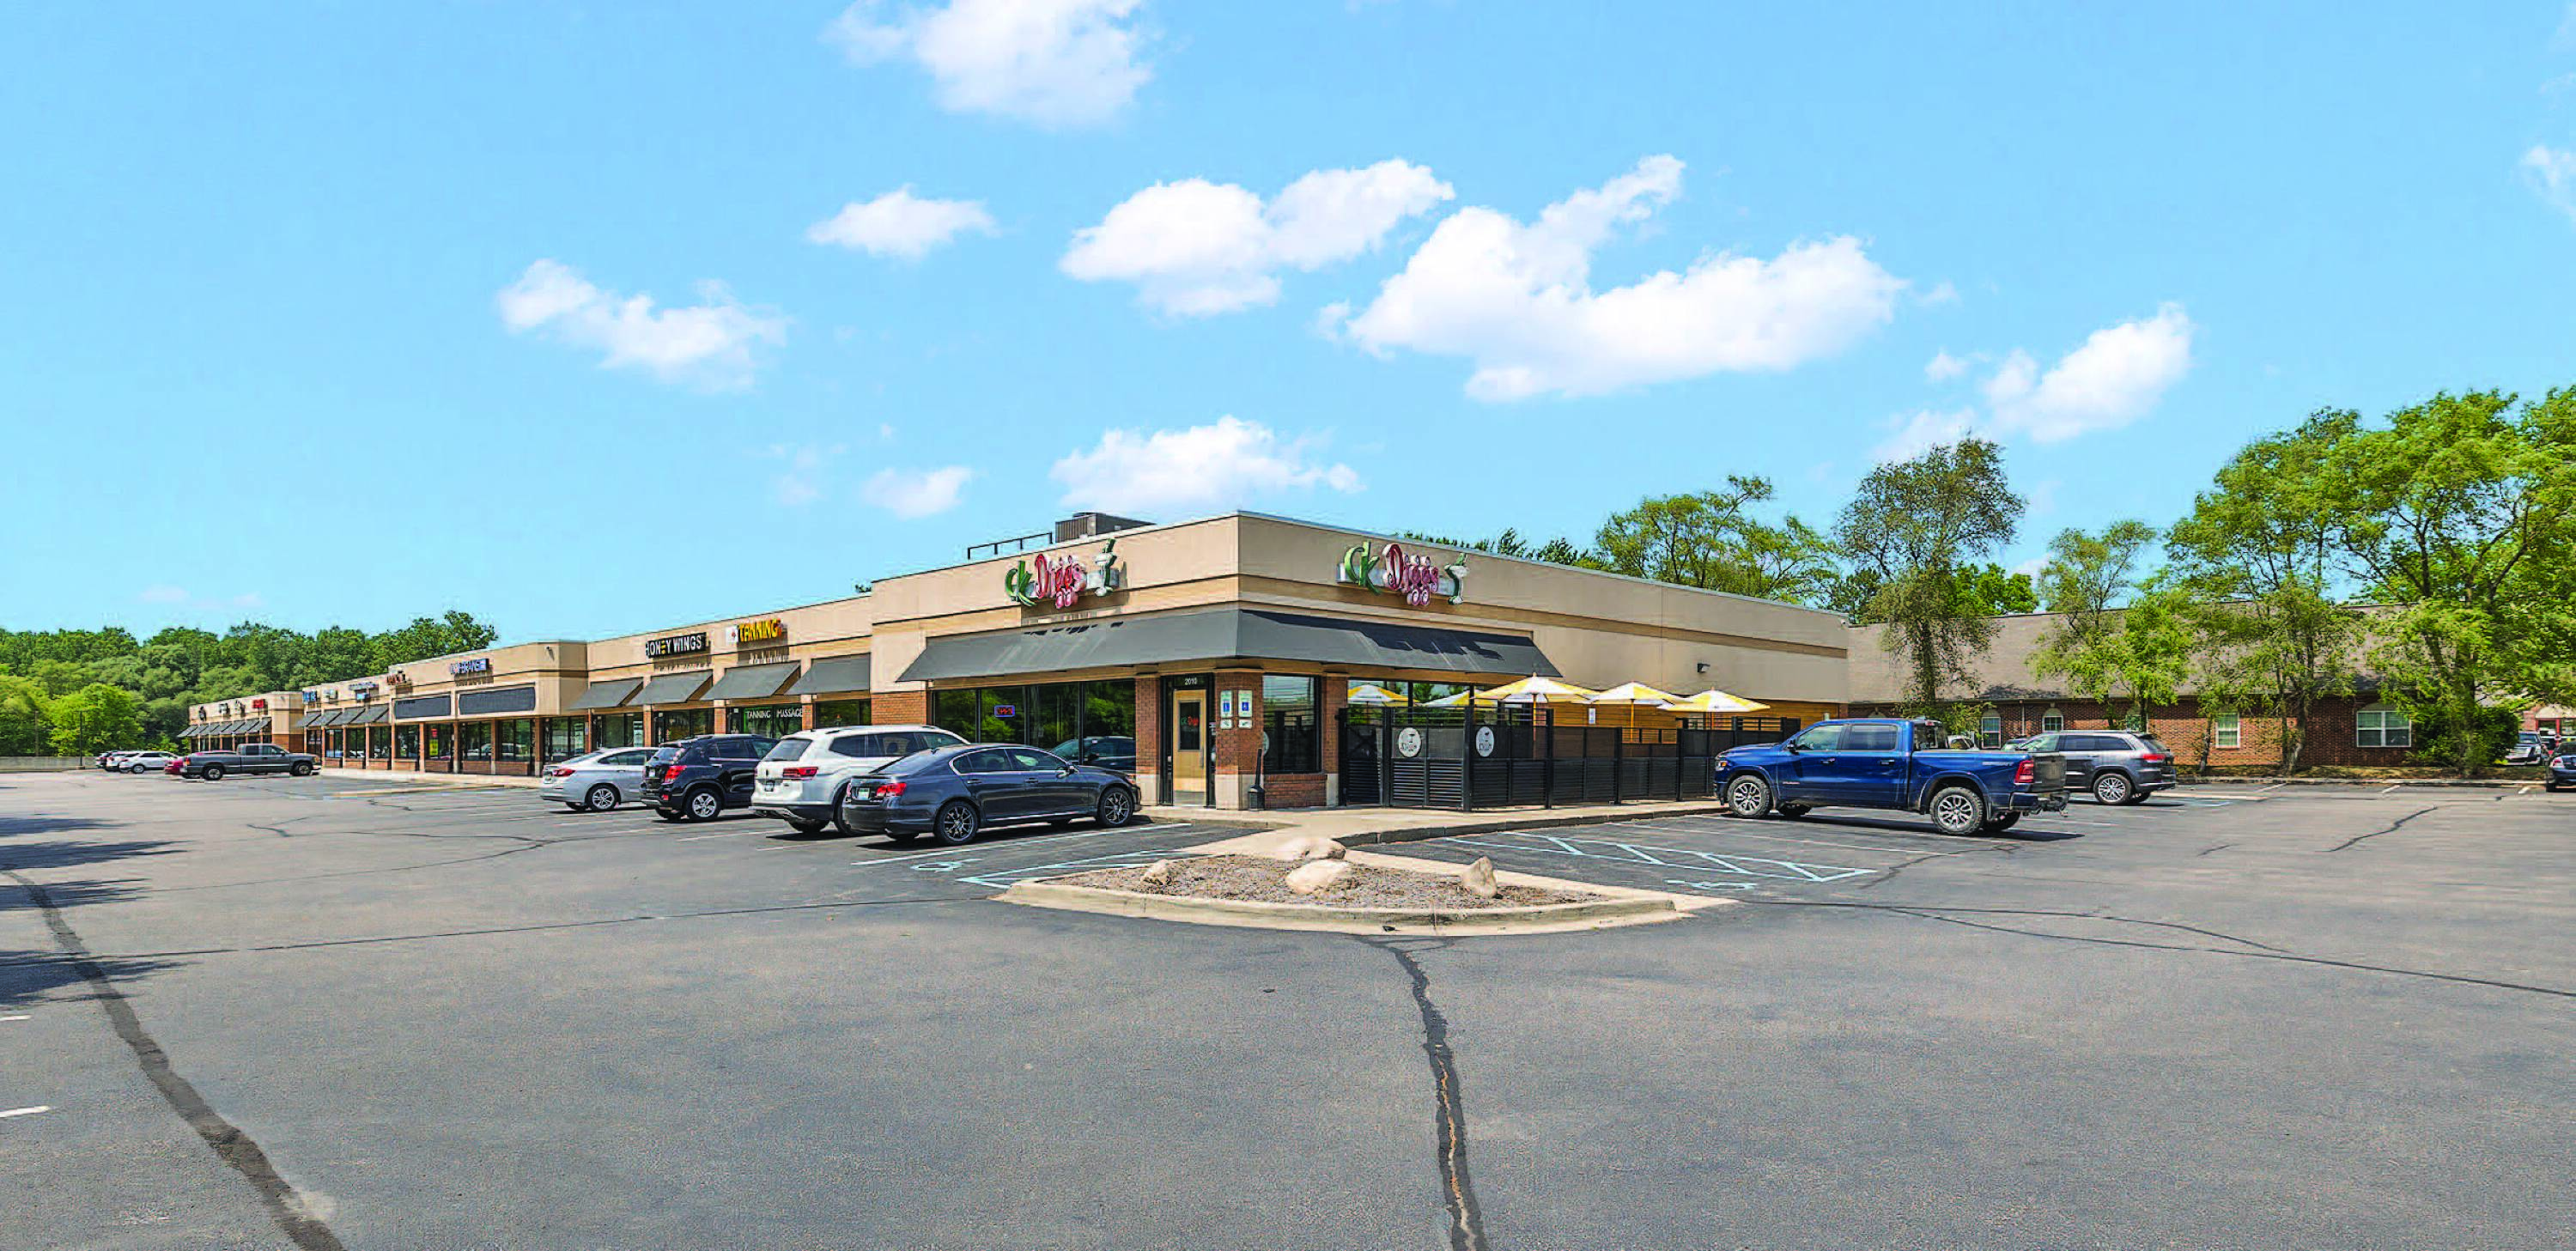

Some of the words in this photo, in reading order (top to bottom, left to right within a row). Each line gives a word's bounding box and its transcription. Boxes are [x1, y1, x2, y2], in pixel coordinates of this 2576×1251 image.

[1035, 554, 1086, 609] Diggs
[1382, 544, 1439, 605] Diggs
[738, 618, 780, 642] TANNING
[673, 635, 702, 653] WINGS
[745, 709, 771, 719] TANNING
[776, 707, 803, 718] MASSAGE
